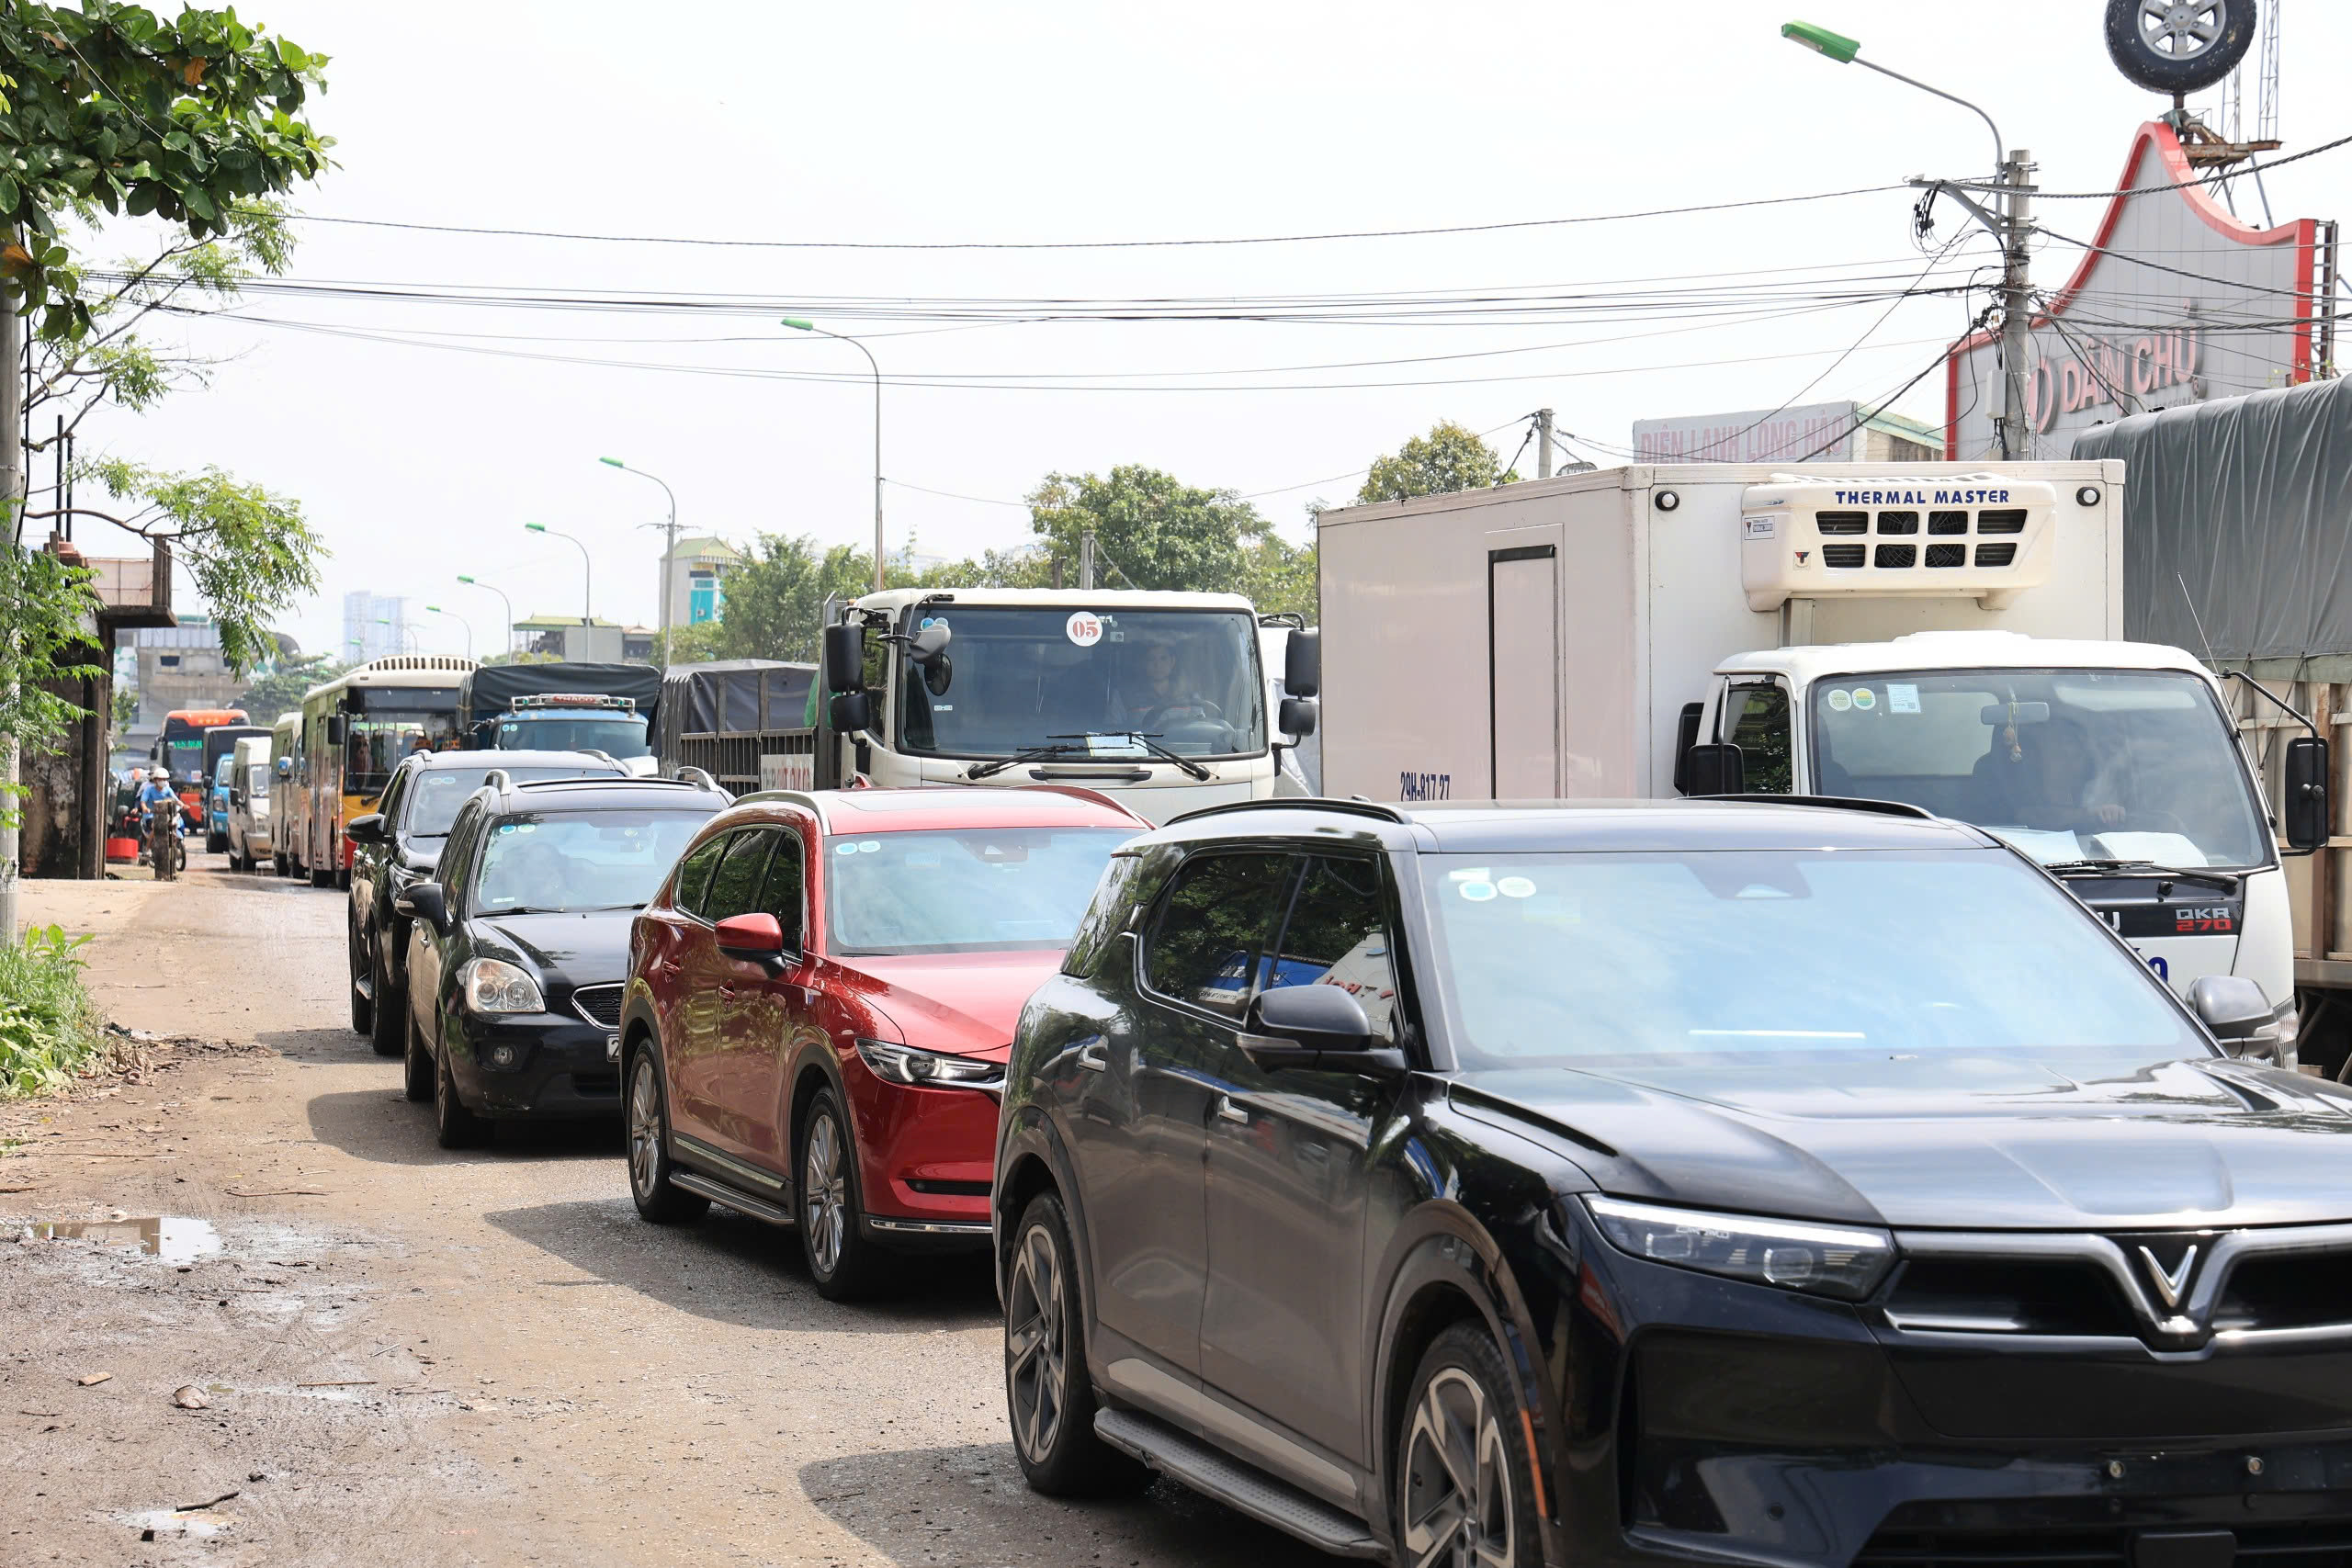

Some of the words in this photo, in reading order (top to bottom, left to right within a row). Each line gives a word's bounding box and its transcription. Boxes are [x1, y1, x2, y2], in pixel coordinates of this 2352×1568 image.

[1747, 419, 1797, 462] LONG
[1836, 491, 1926, 504] THERMAL
[1934, 490, 2009, 504] MASTER
[1072, 620, 1099, 638] 05
[2176, 908, 2231, 919] QKR
[2176, 919, 2233, 932] 270
